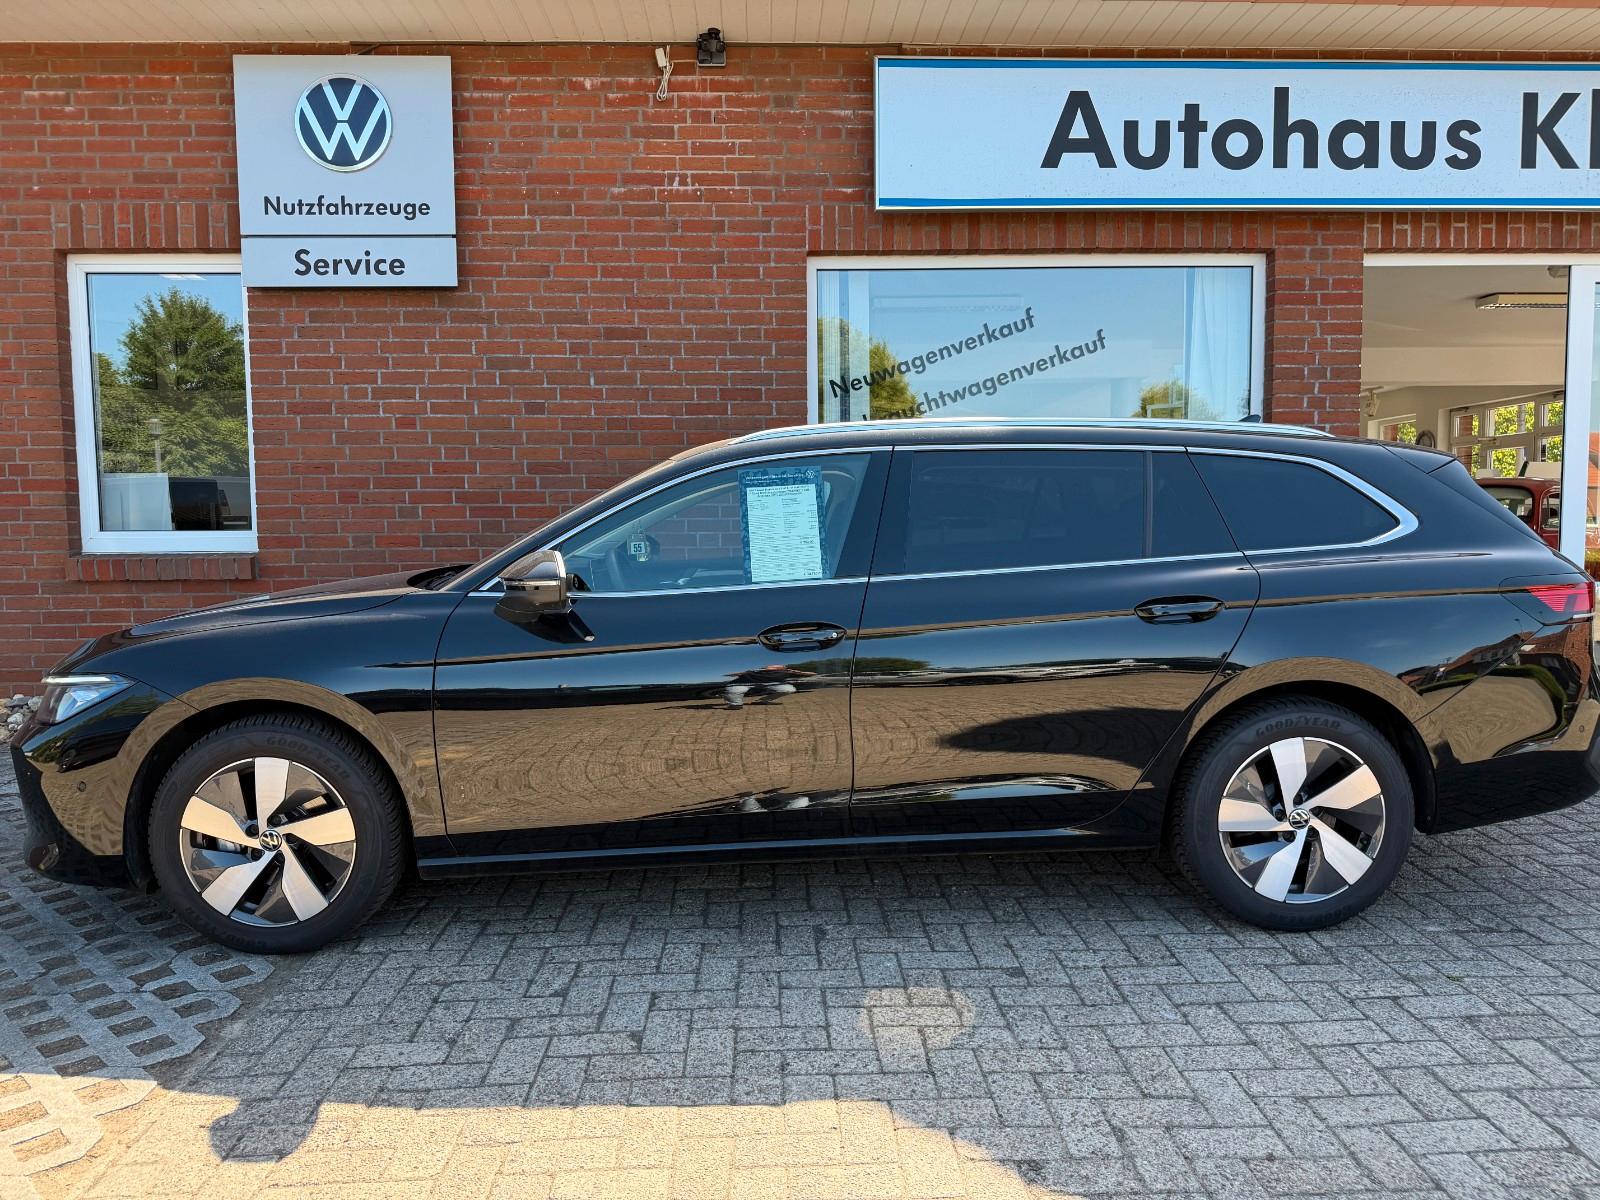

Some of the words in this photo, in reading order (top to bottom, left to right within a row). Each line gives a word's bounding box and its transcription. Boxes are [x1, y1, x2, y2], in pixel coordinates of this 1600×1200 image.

[1040, 86, 1482, 171] Autohaus
[263, 194, 431, 221] Nutzfahrzeuge
[294, 248, 406, 276] Service
[828, 306, 1036, 399] Neuwagenverkauf
[633, 543, 643, 553] 55
